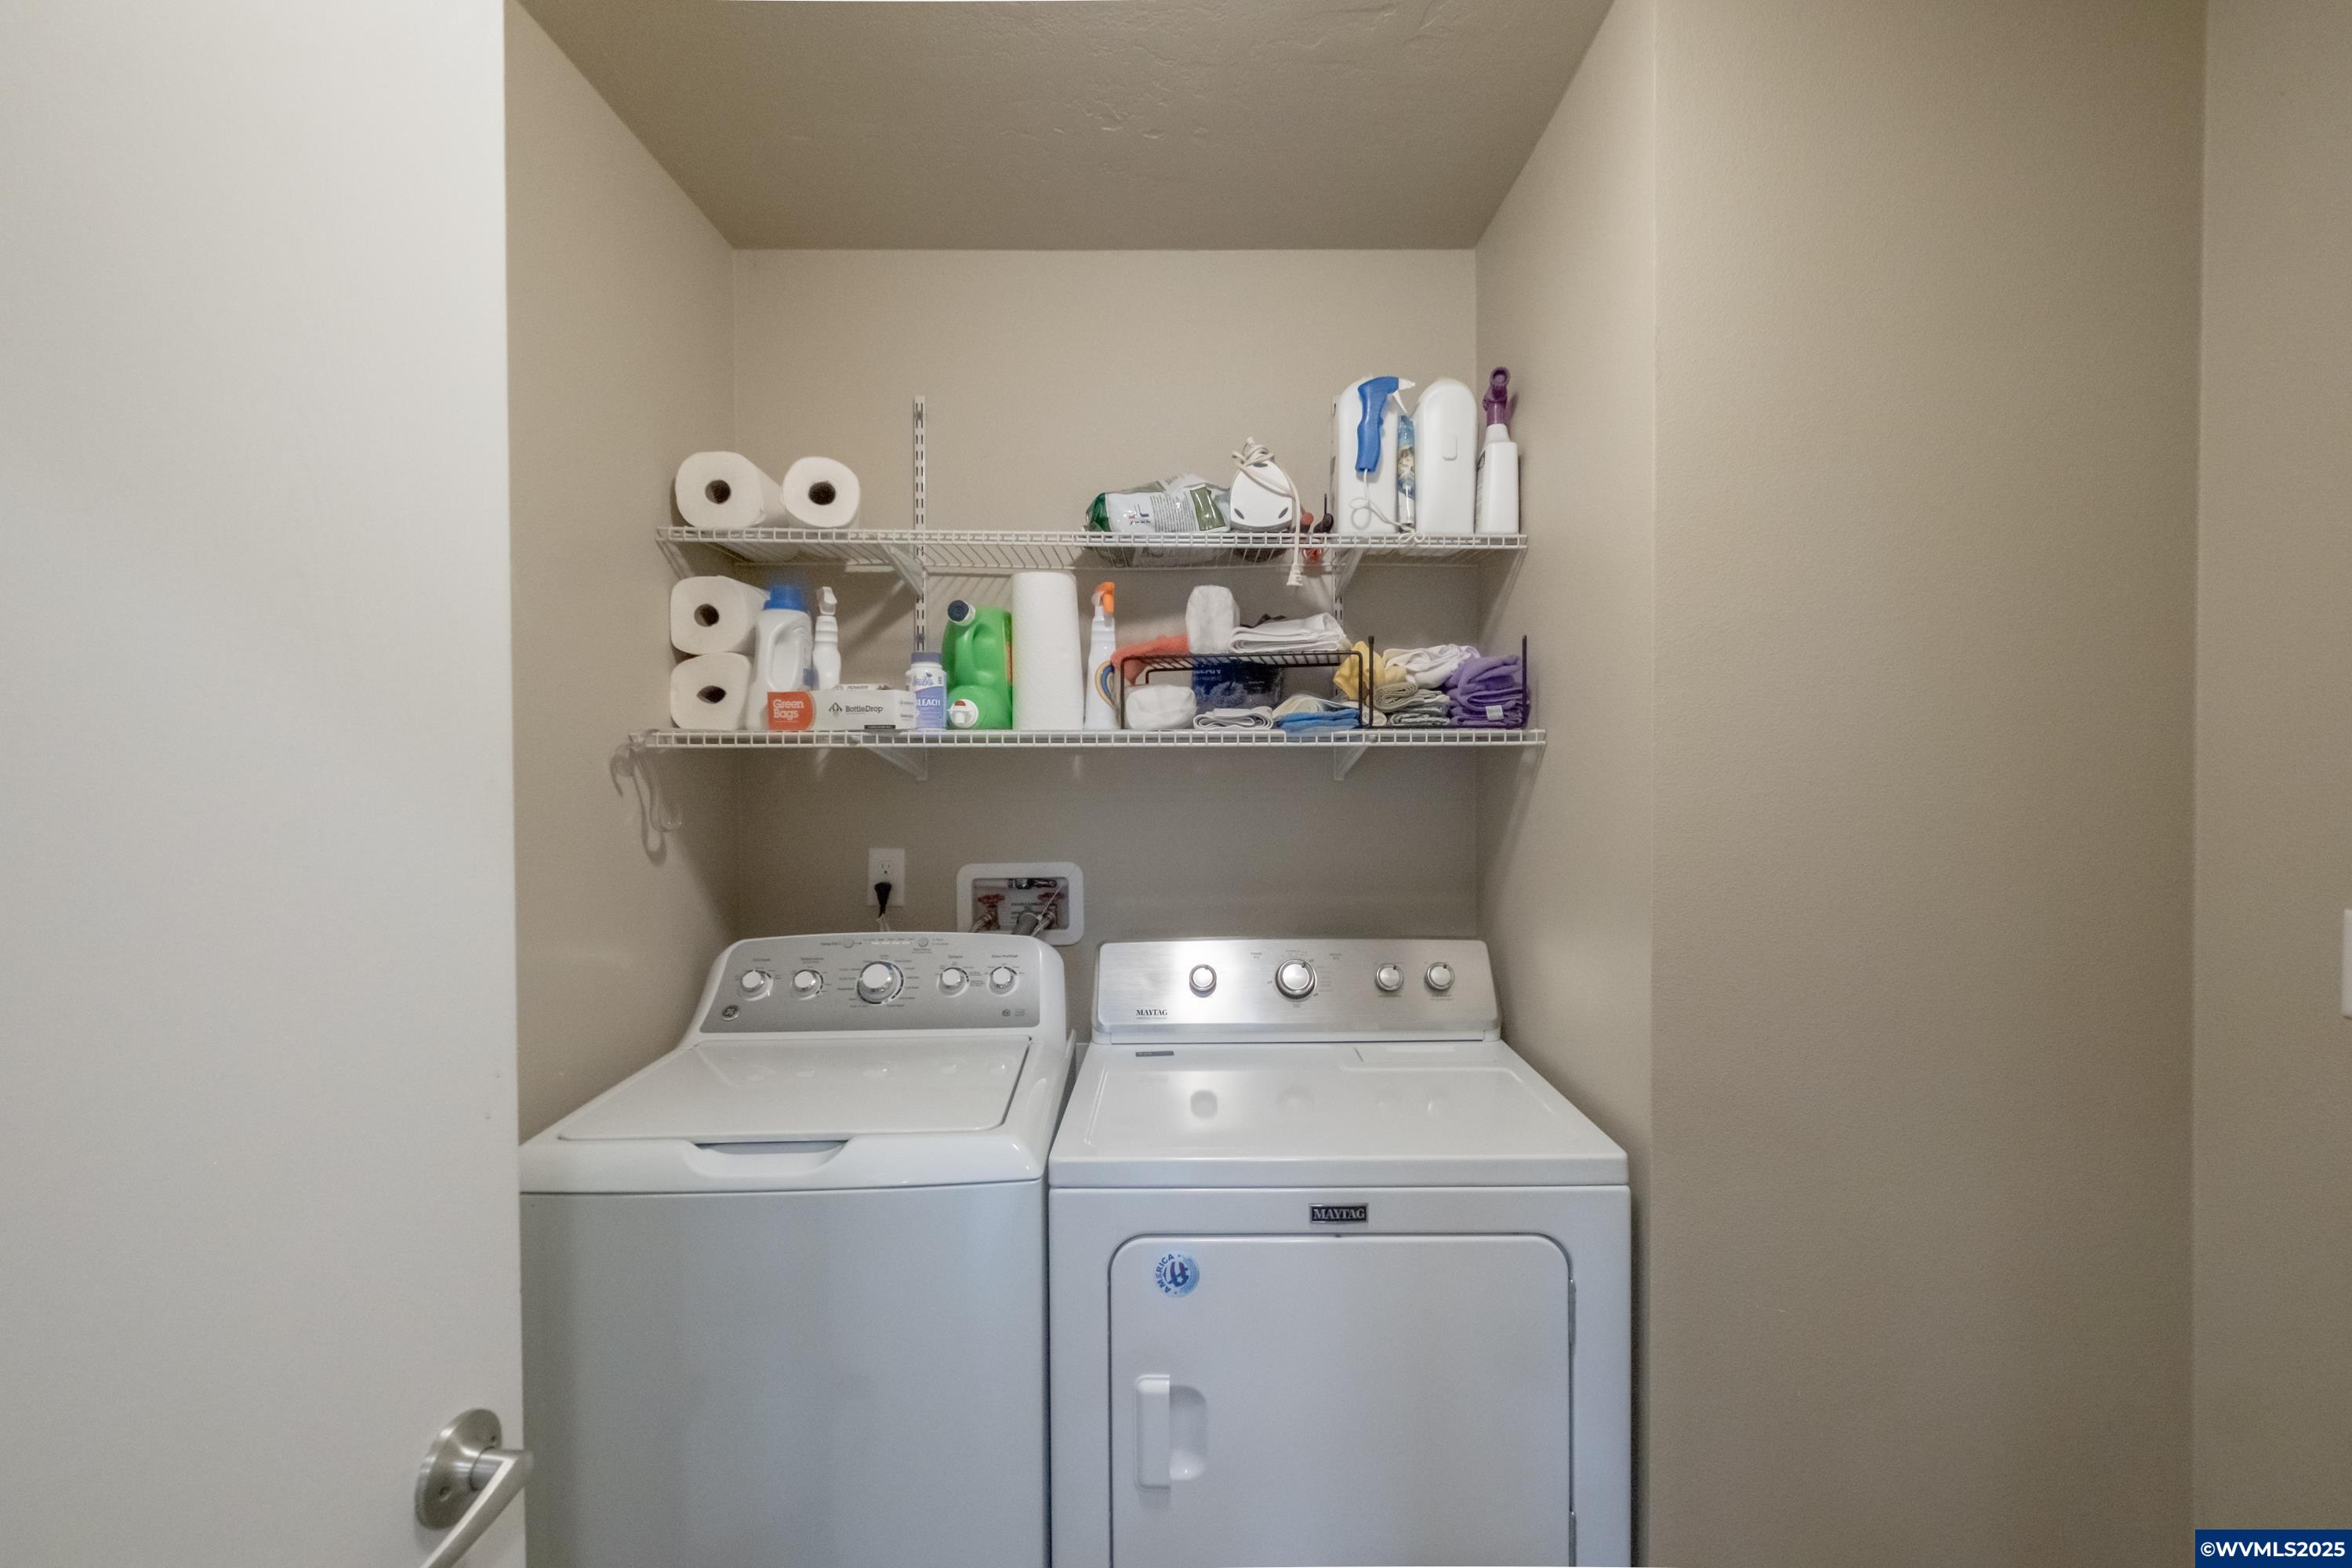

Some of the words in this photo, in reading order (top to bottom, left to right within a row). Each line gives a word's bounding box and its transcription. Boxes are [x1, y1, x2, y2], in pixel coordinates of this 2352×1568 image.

[773, 699, 804, 709] Green
[845, 705, 884, 713] BottleDrop
[774, 708, 799, 720] Bags
[1313, 1208, 1365, 1219] MAYTAG
[1156, 1254, 1174, 1293] AMERICA
